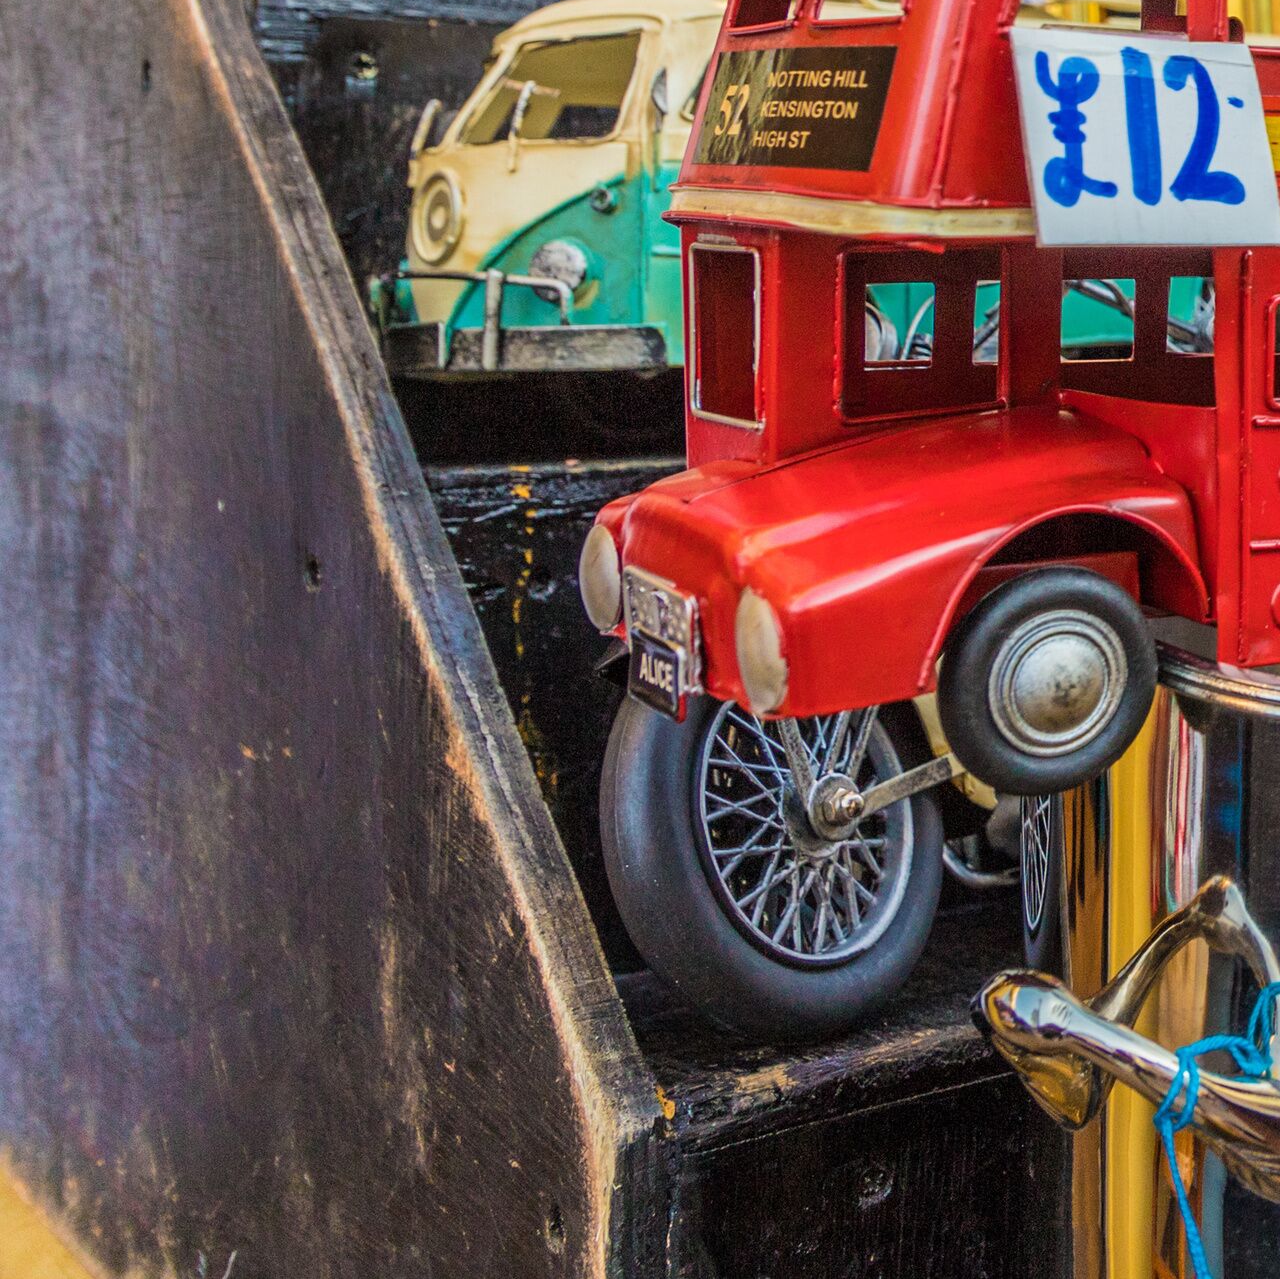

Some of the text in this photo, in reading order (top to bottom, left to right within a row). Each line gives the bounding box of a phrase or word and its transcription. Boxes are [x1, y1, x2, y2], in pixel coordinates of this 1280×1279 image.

[767, 70, 869, 88] NOTTING HILL
[714, 83, 750, 136] 52
[760, 100, 859, 119] KENSINGTON
[752, 130, 811, 149] HIGH ST
[638, 652, 674, 694] ALICE
